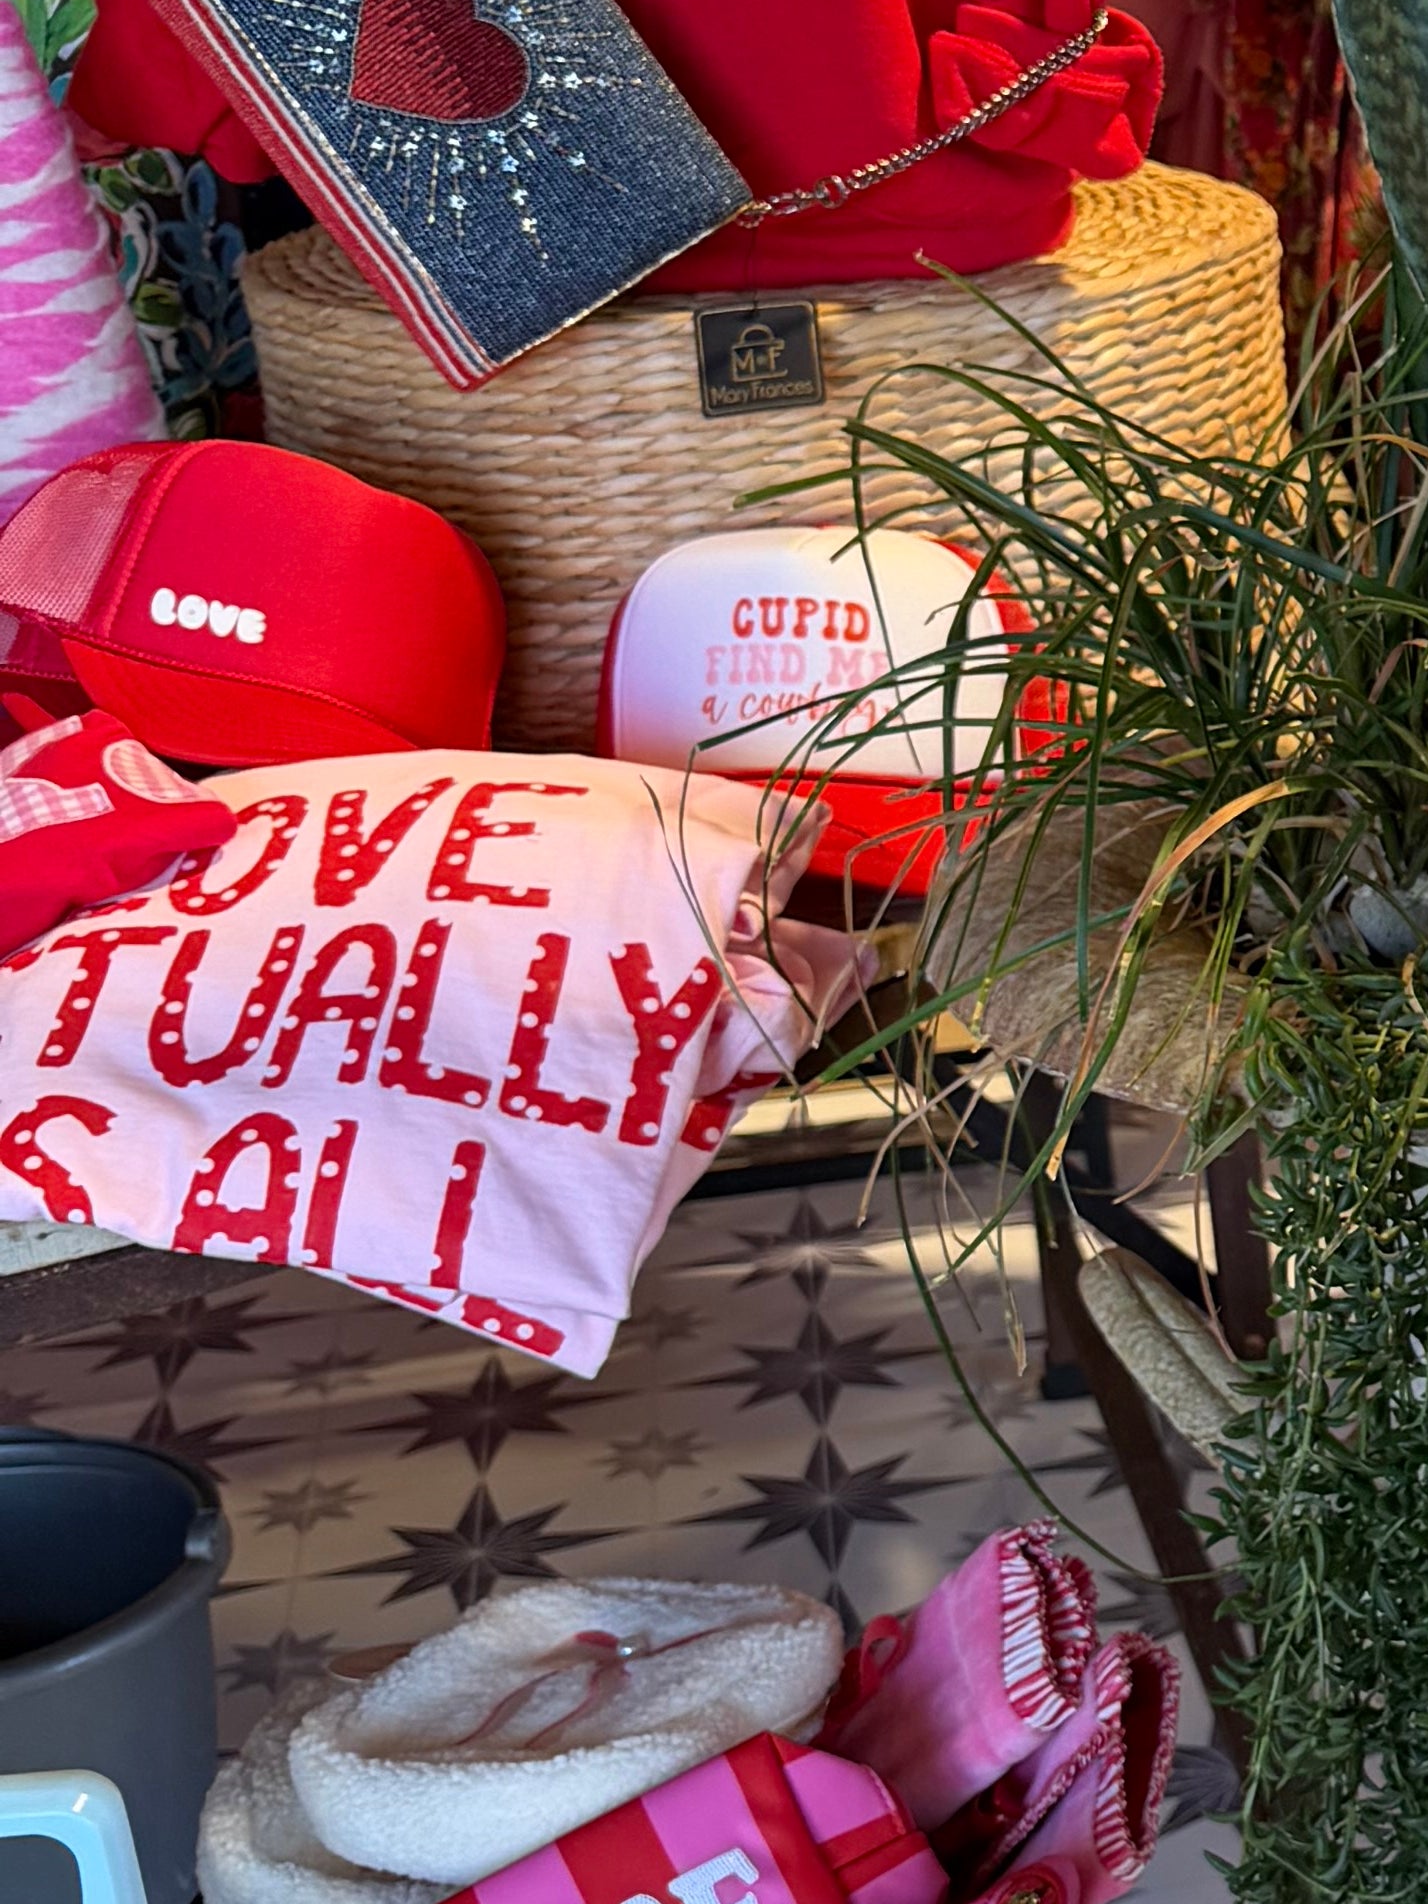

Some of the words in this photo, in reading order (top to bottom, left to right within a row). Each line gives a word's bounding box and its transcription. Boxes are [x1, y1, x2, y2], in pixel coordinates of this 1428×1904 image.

[709, 383, 749, 406] Mary
[751, 380, 814, 401] Frances
[151, 587, 267, 644] LOVE
[732, 597, 870, 643] CUPID
[704, 643, 807, 687] FIND
[702, 693, 728, 725] a
[90, 777, 588, 916] OVE
[0, 917, 723, 1147] TUALLY
